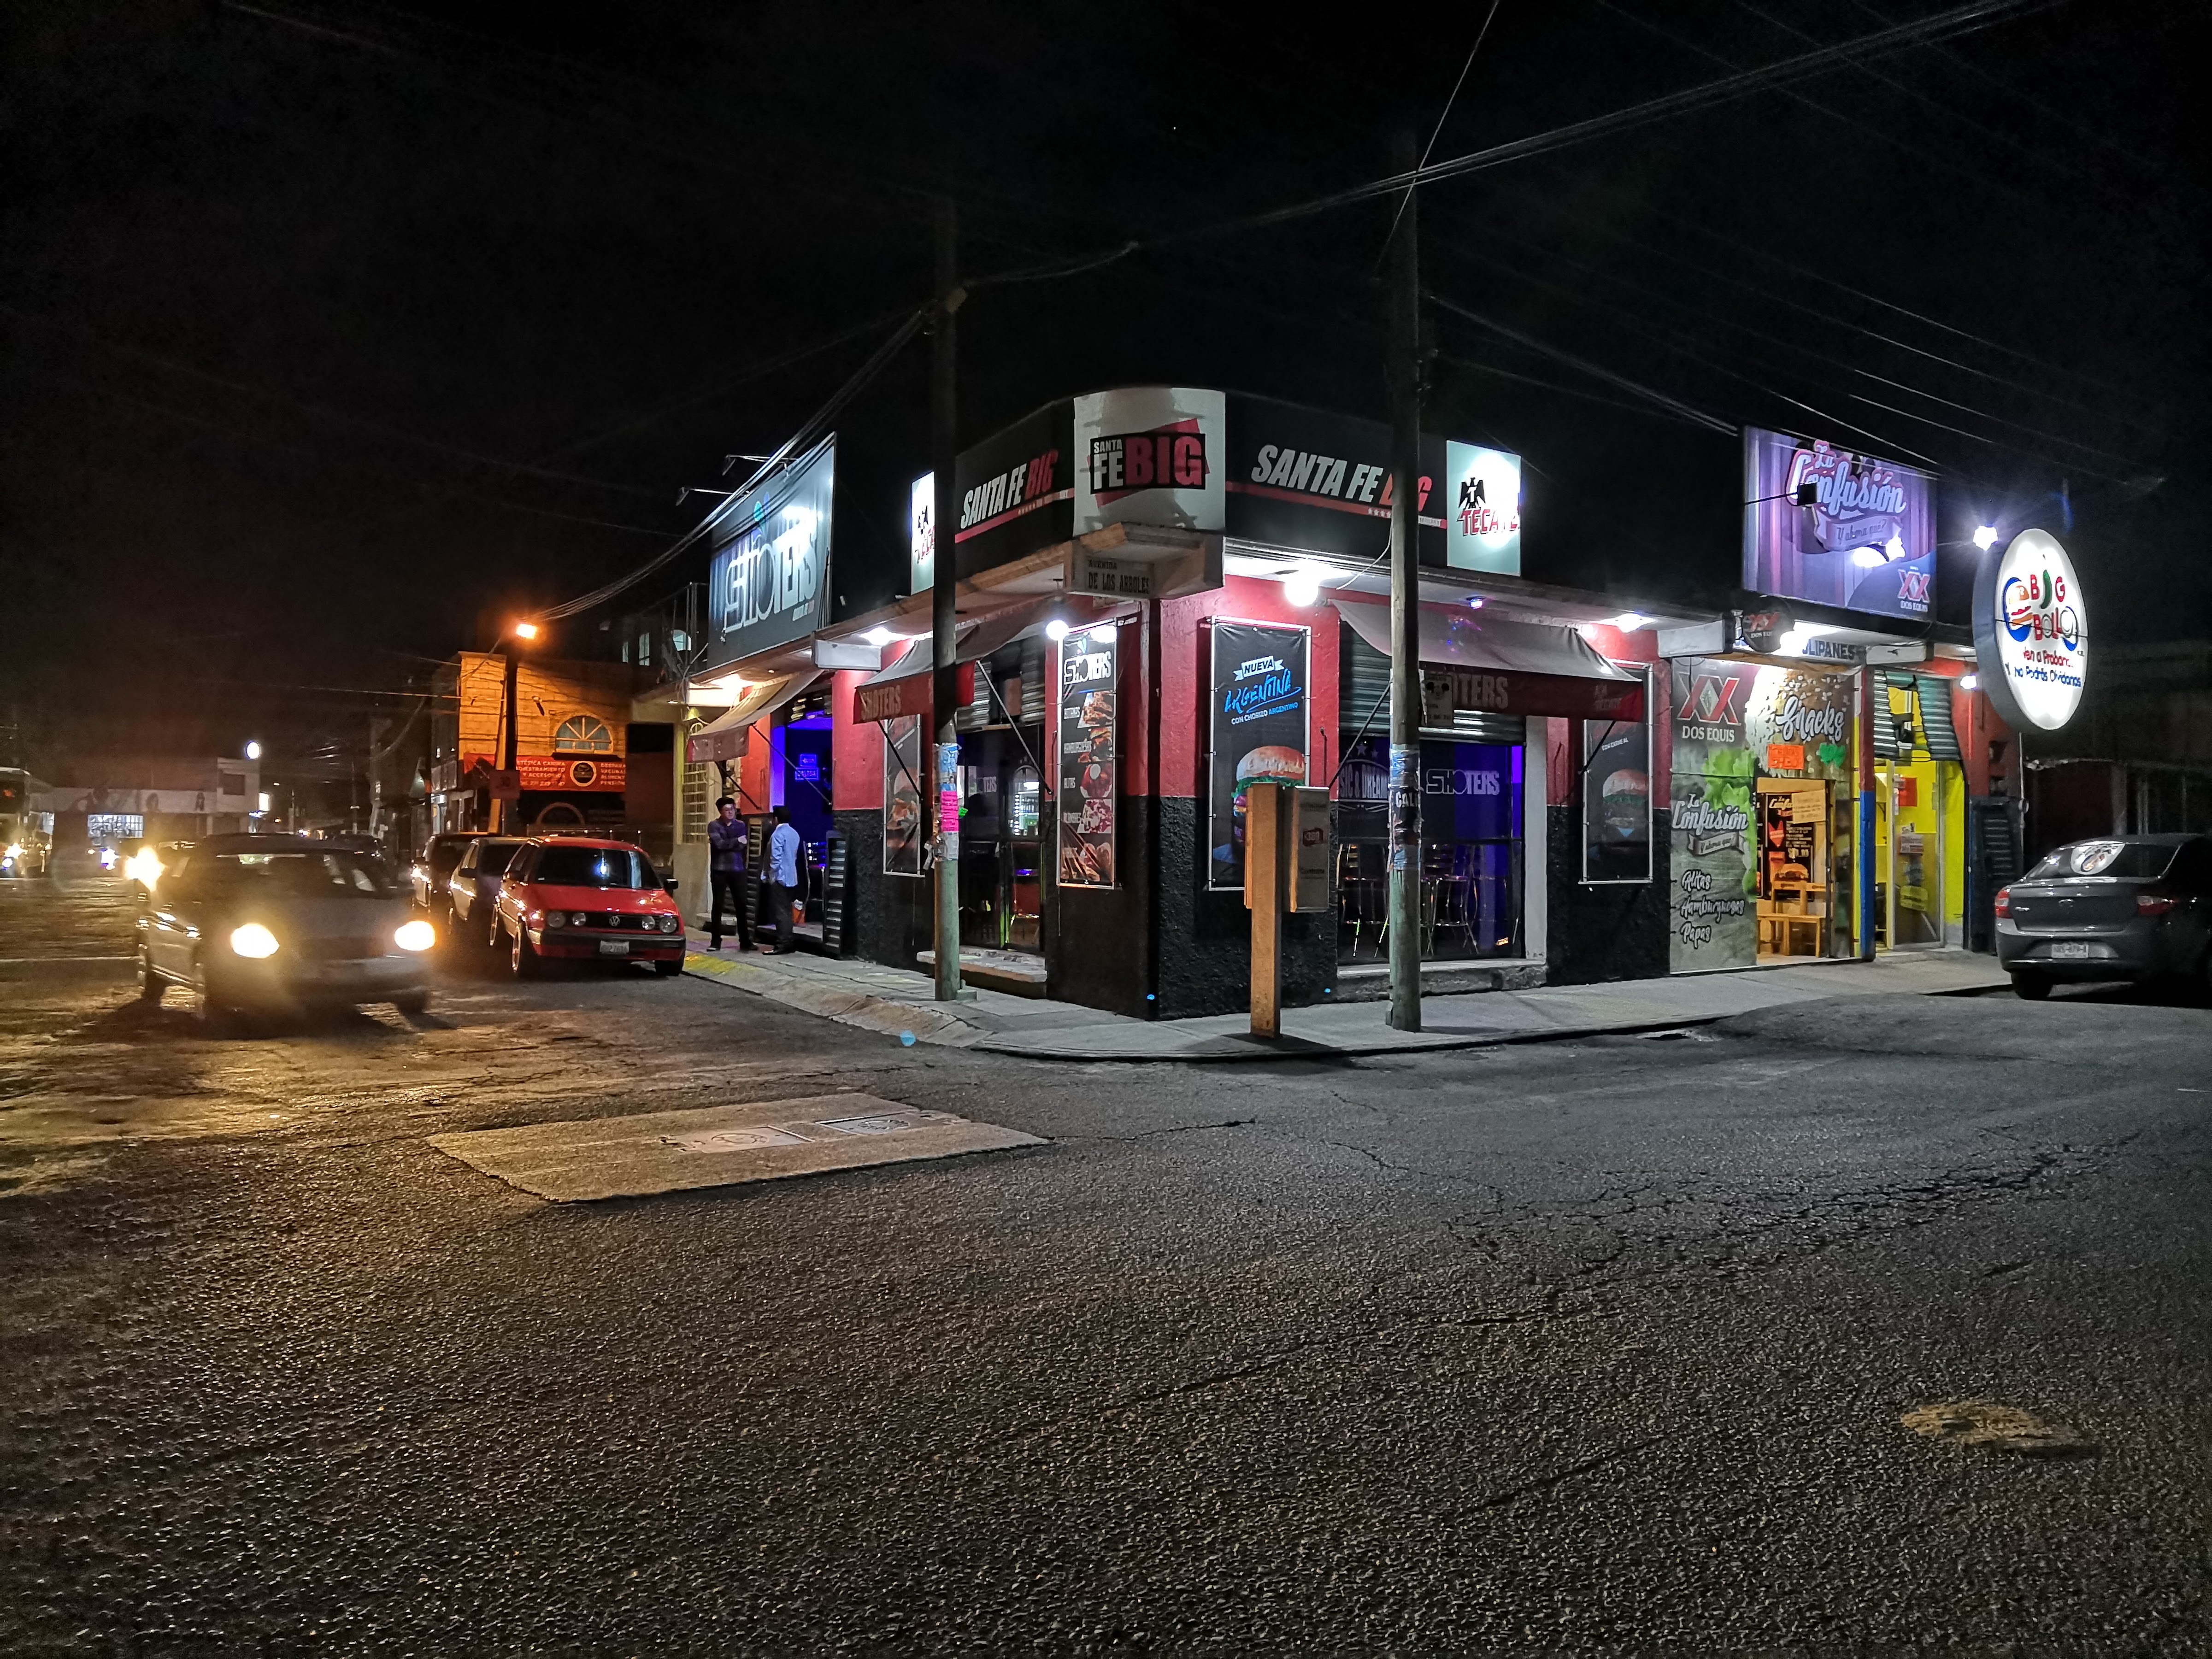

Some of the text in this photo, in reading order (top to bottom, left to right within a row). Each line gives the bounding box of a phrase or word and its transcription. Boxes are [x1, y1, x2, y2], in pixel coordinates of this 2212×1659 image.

[1094, 440, 1123, 453] SANTA
[1094, 435, 1202, 489] FE BIG
[1252, 444, 1347, 496] SANTA
[1345, 463, 1383, 503] FE
[961, 449, 1059, 529] SANTA FE BIG
[1457, 509, 1519, 536] TECAE
[1088, 572, 1149, 594] DE LOS ARBOLES
[1244, 659, 1273, 674] NUEVA
[1447, 671, 1508, 709] TERS
[1677, 671, 1741, 726] XX
[1231, 702, 1299, 725] CON CHORIZO ARGENTINO
[1775, 696, 1844, 741] Snacks
[1682, 725, 1735, 742] DOS EQUIS
[1362, 764, 1389, 799] DREAM
[1425, 769, 1500, 795] SHOTERS
[1688, 794, 1700, 808] La
[1672, 801, 1748, 835] Confusión
[1682, 870, 1712, 892] Alitas
[1681, 895, 1745, 924] Hamburguesas
[1681, 921, 1711, 949] Papas
